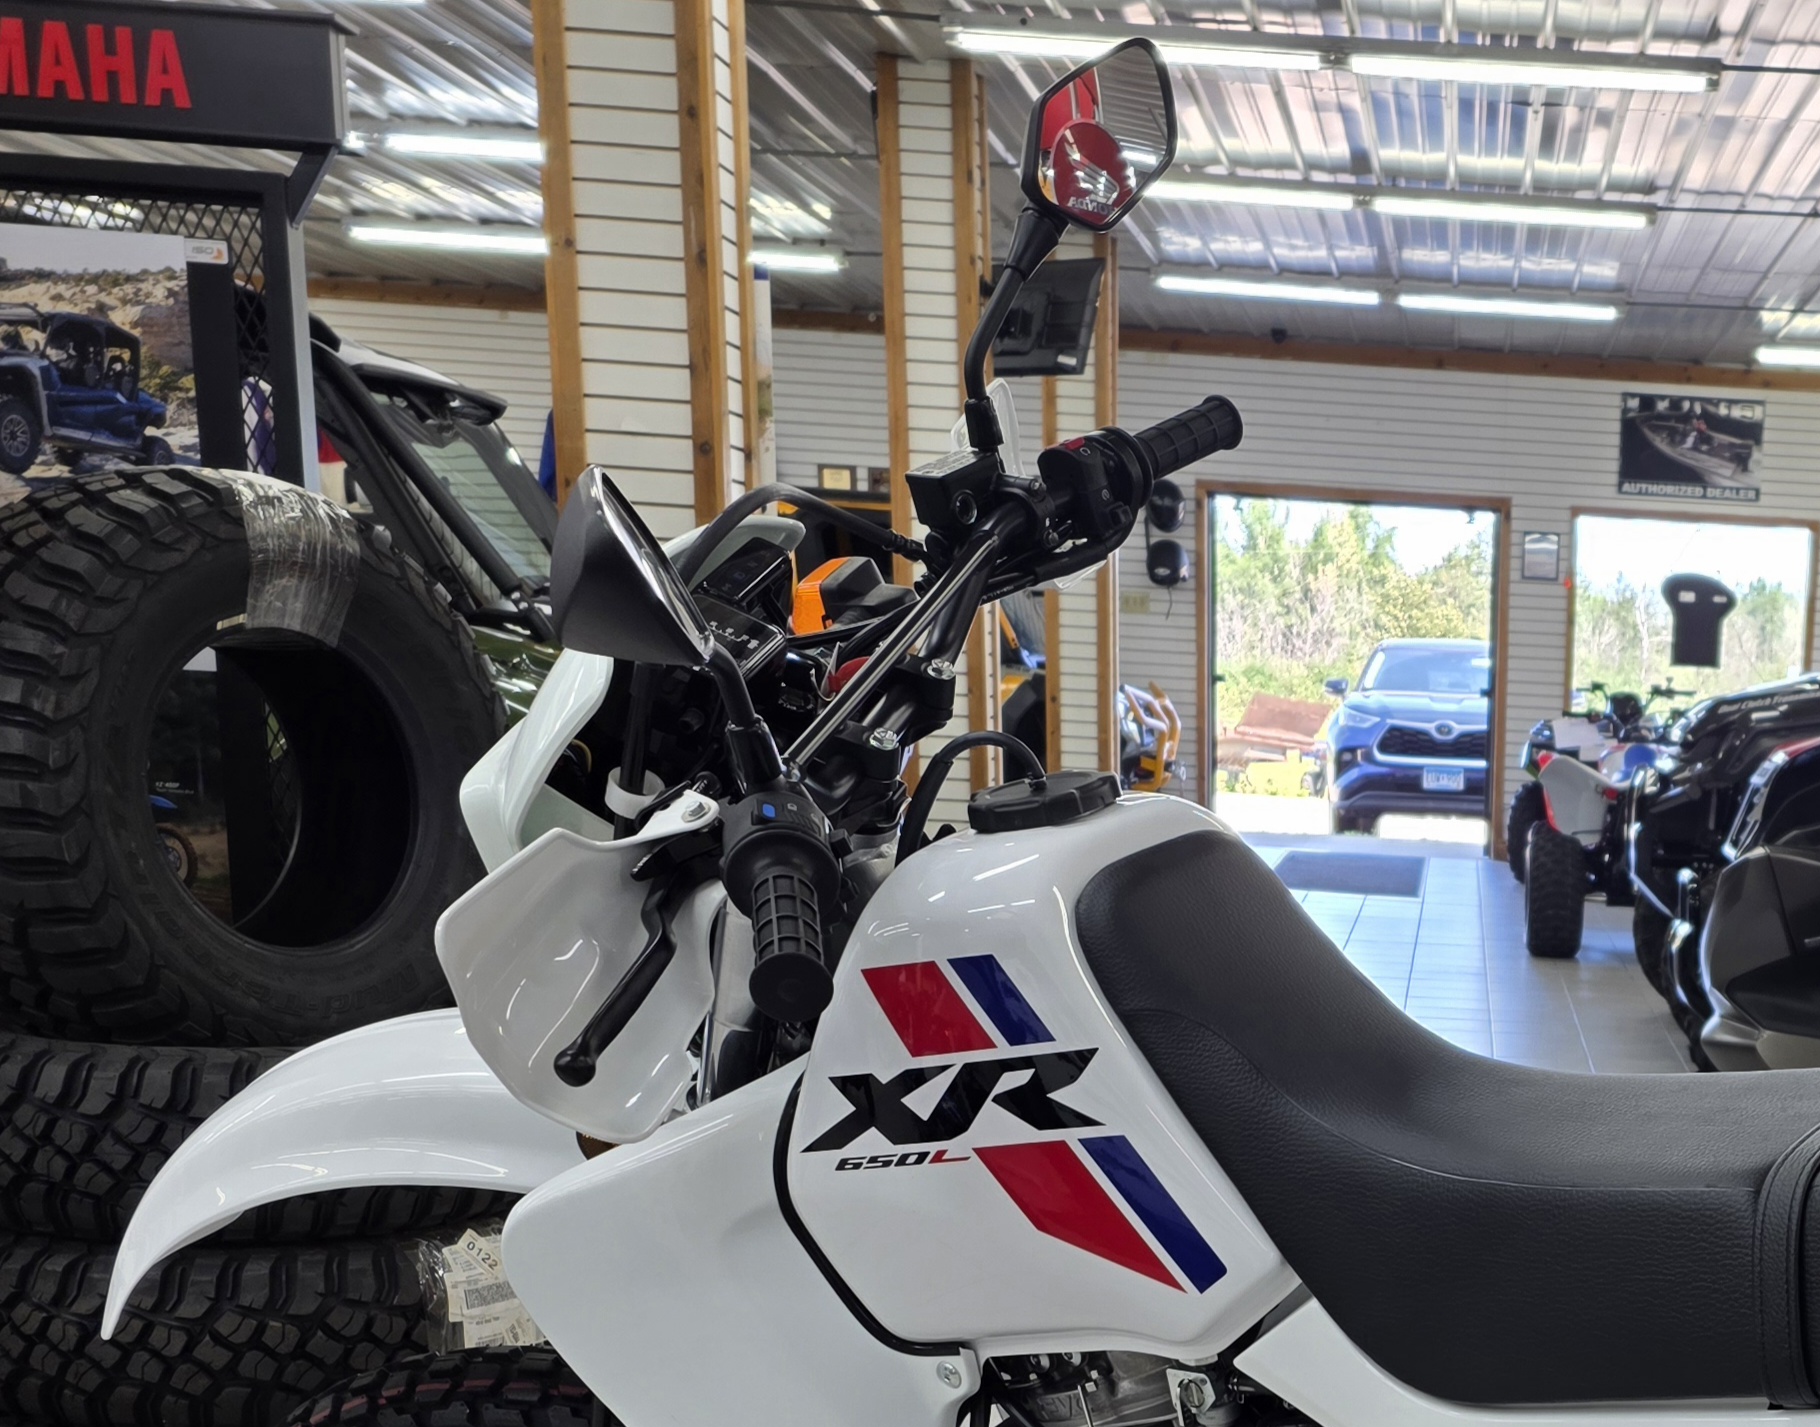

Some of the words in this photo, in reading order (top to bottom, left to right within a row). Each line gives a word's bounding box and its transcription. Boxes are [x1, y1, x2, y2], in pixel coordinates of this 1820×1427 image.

[1621, 482, 1704, 498] AUTHORIZED
[1706, 487, 1756, 500] DEALER
[801, 1047, 1107, 1153] XR
[834, 1149, 971, 1172] 650L
[466, 1241, 498, 1271] 0122
